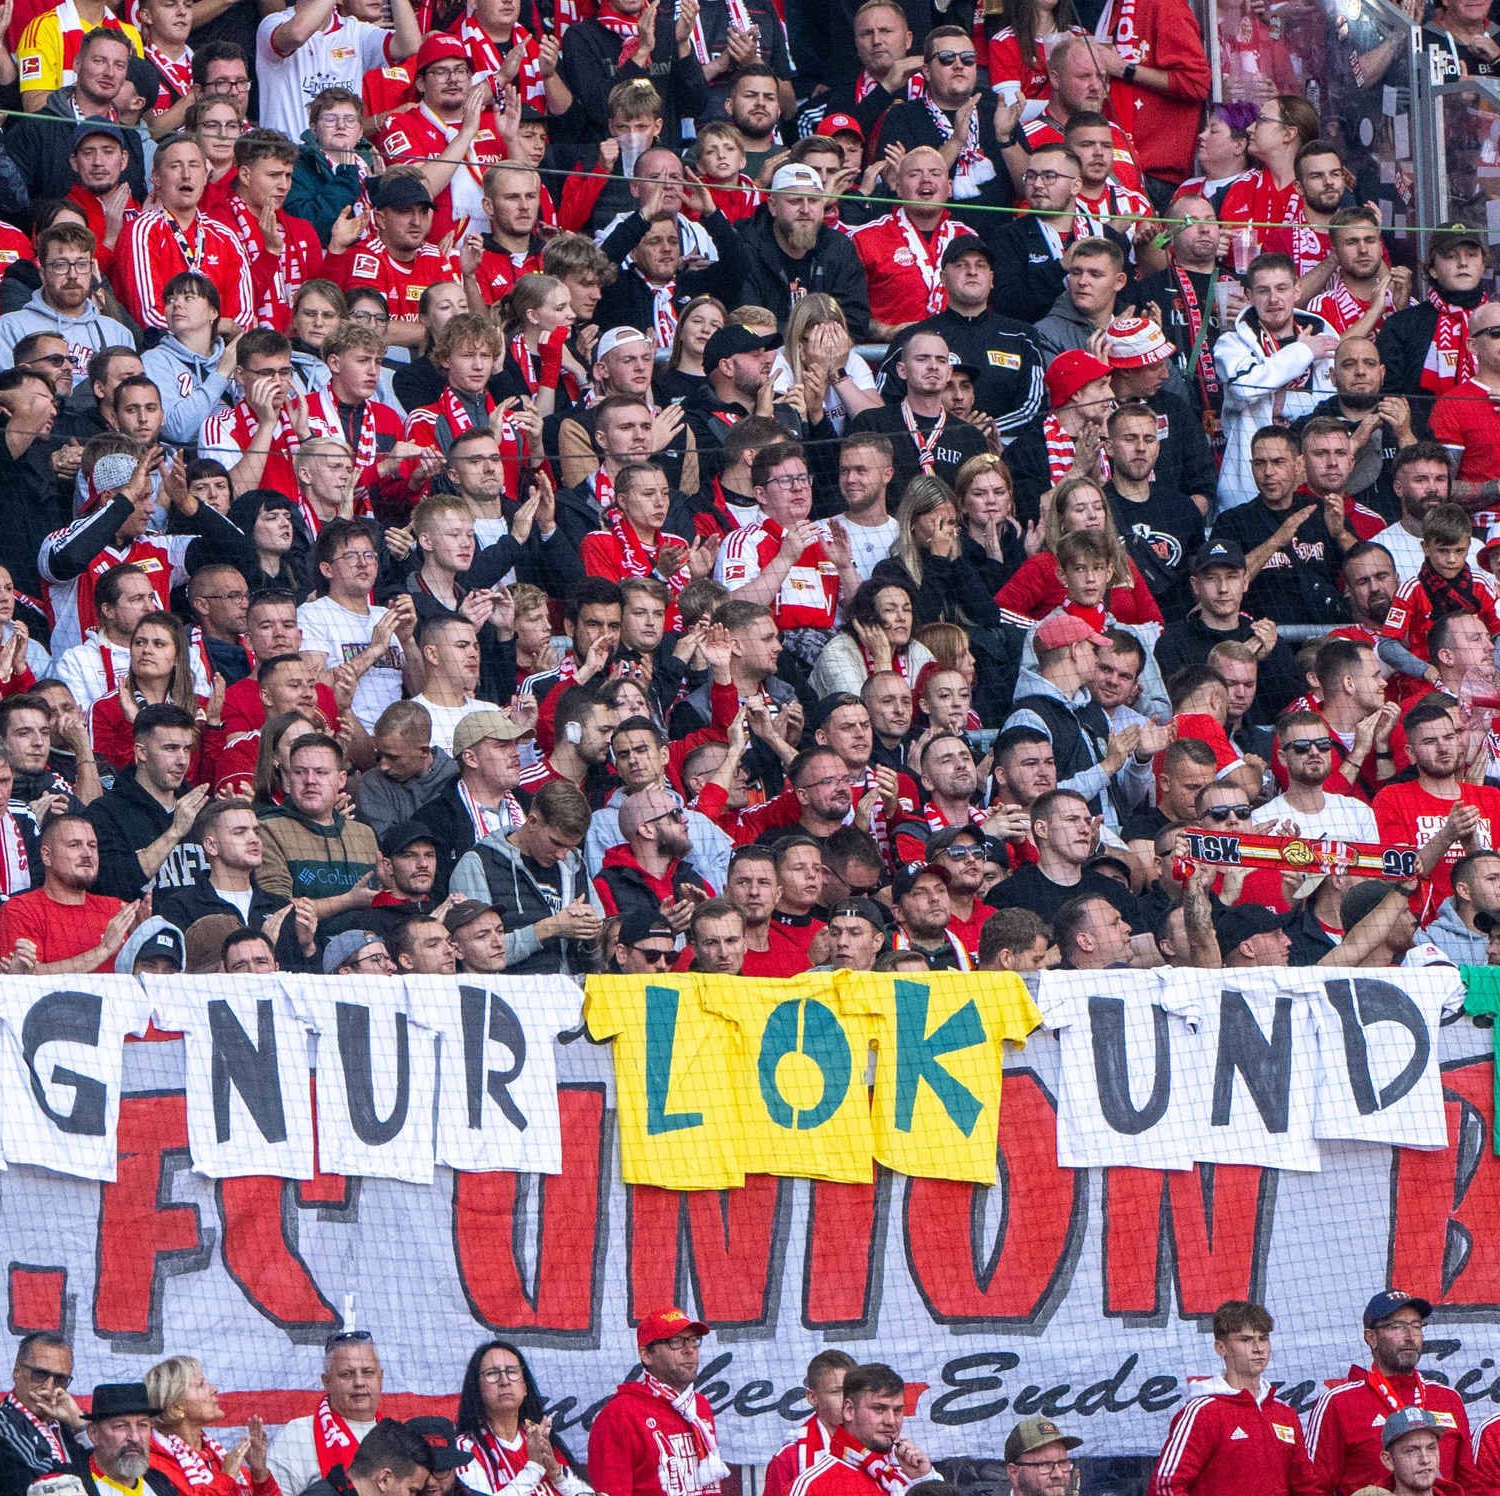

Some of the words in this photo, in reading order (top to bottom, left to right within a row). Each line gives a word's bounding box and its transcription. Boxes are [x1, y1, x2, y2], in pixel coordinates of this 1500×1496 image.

[207, 985, 529, 1146] NUR
[645, 979, 987, 1138] LOK
[1088, 978, 1431, 1135] UND
[928, 1352, 1183, 1427] Ende
